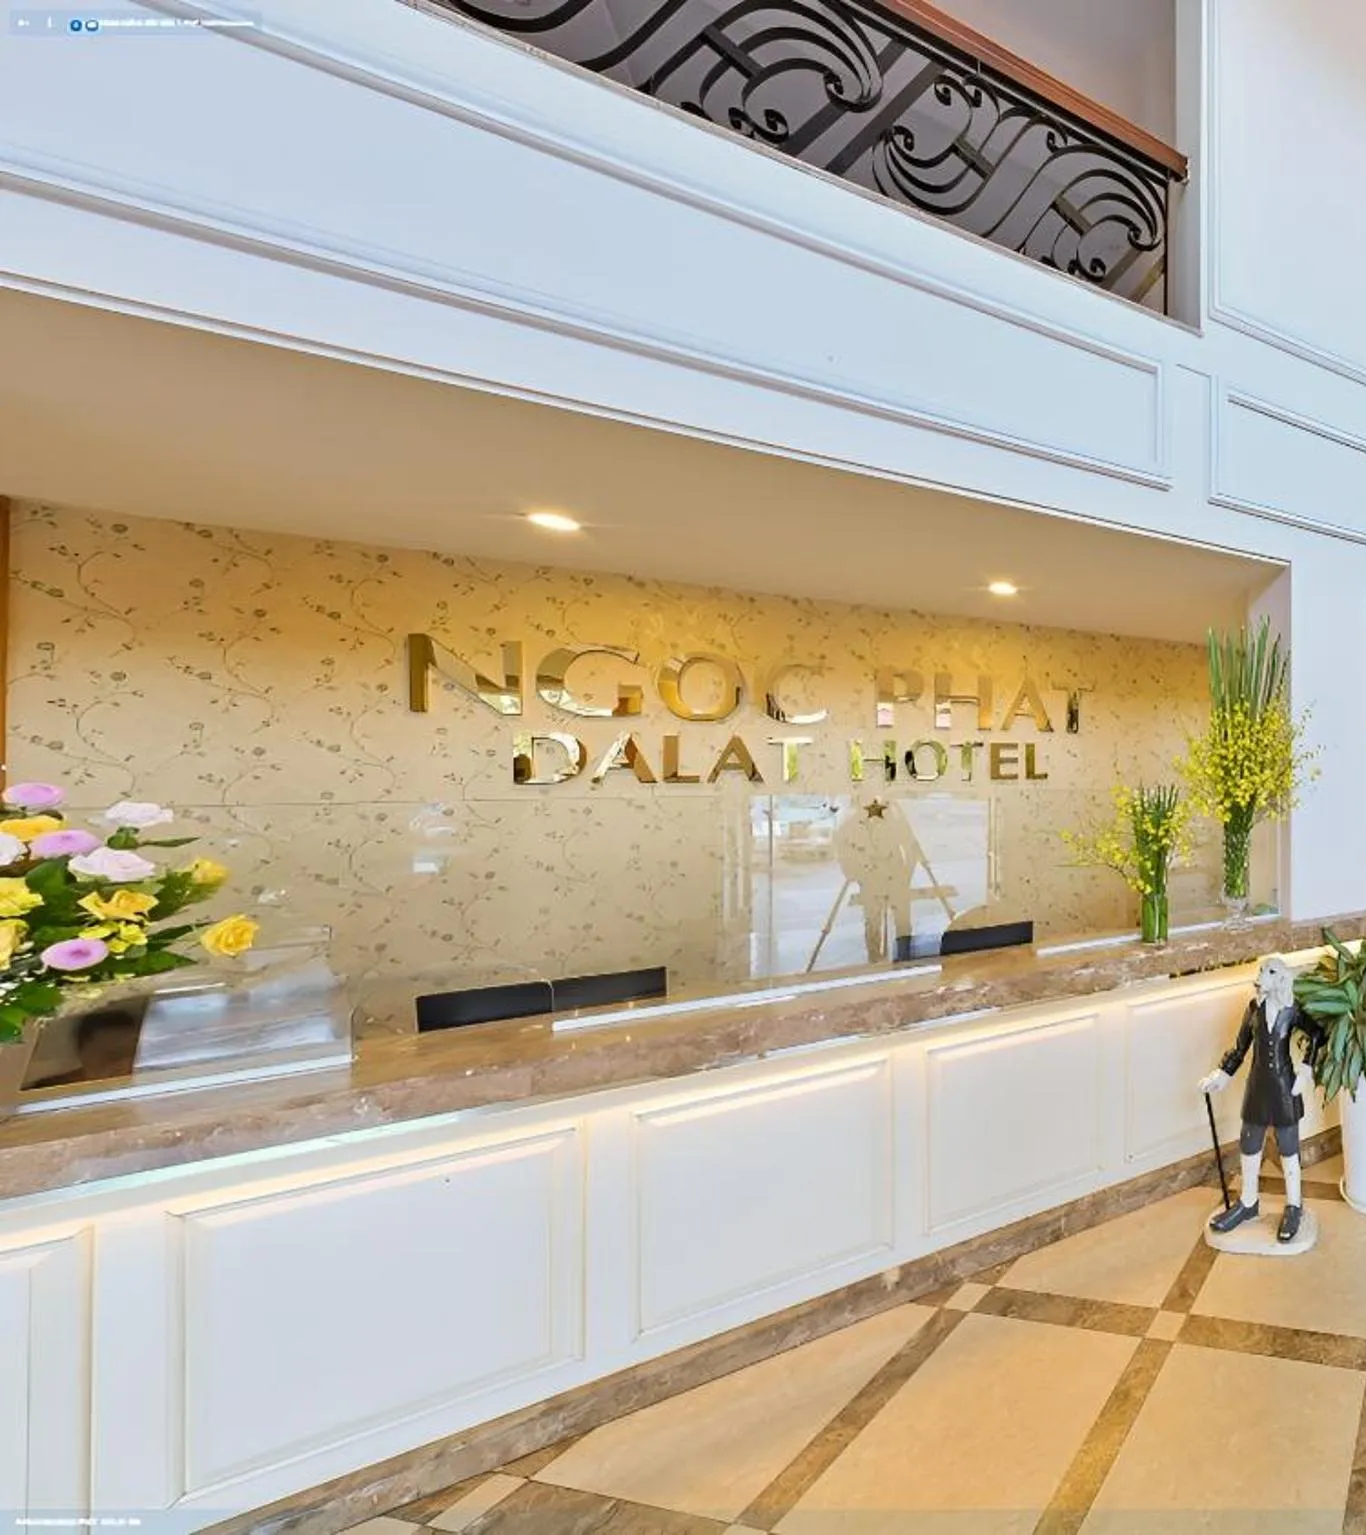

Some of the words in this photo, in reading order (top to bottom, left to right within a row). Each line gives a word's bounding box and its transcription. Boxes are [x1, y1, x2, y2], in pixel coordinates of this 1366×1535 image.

[407, 632, 829, 724] NGOC
[874, 664, 1096, 733] PHAT
[512, 732, 814, 785] DALAT
[850, 738, 1049, 783] HOTEL
